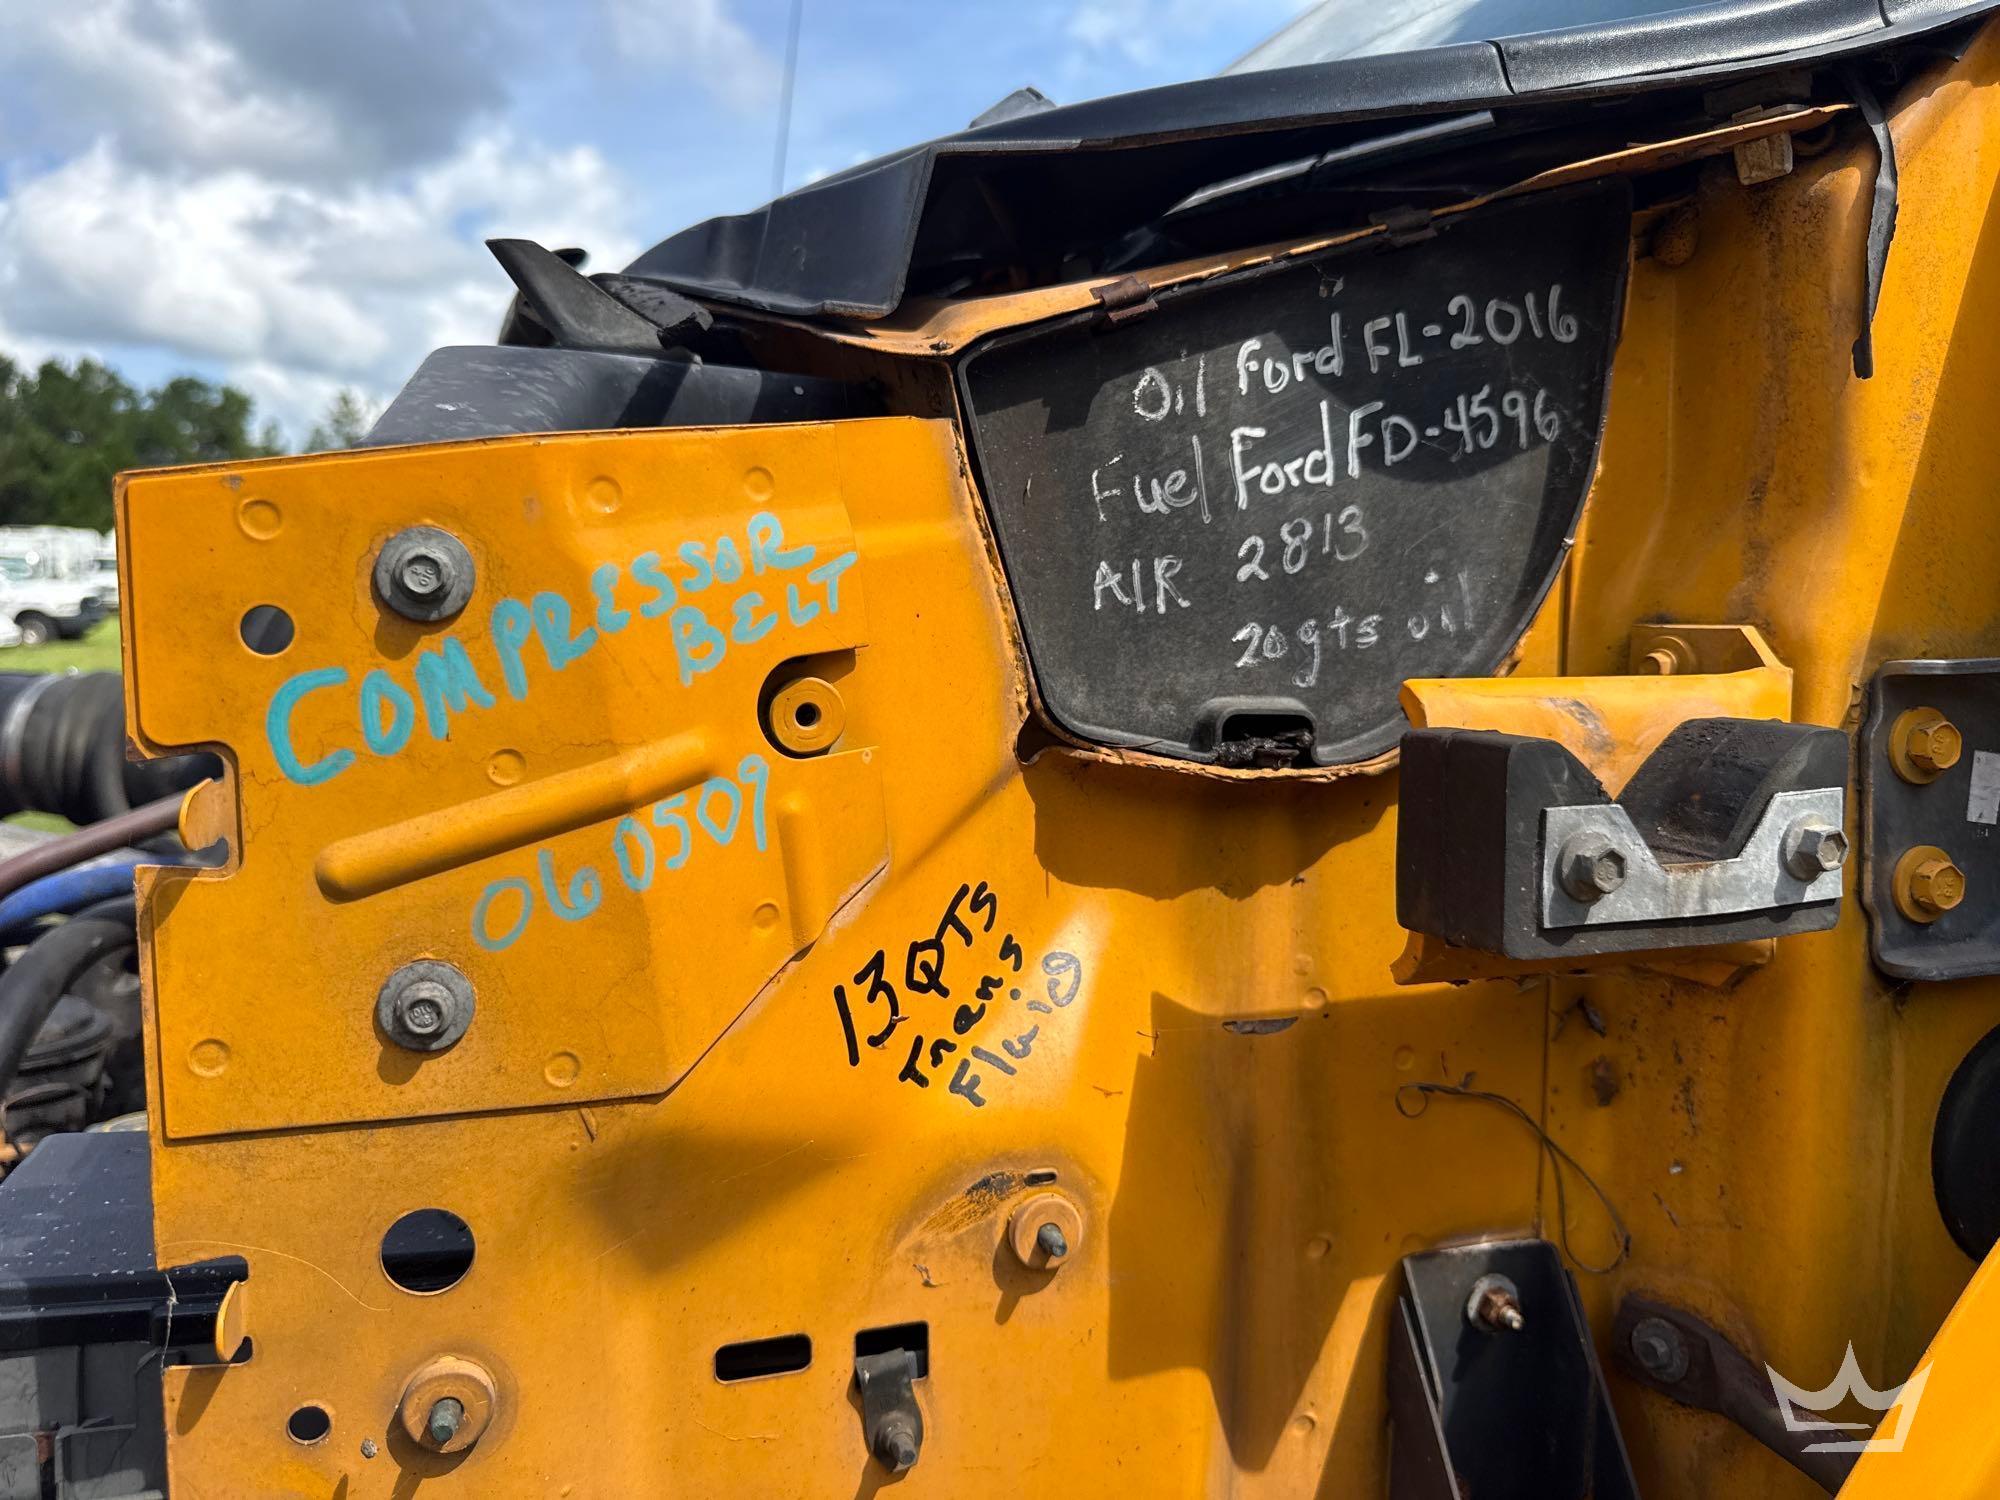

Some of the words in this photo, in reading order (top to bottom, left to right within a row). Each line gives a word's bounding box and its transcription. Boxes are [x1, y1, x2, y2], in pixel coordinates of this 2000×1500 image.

[1133, 353, 1207, 421] Oil
[1237, 311, 1343, 395] Ford
[1363, 284, 1579, 375] FL-2016
[1092, 435, 1213, 523] Fuel
[1229, 400, 1334, 510] Ford
[1347, 384, 1560, 480] FD-4596
[670, 551, 858, 686] BELT
[1093, 555, 1192, 615] AIR
[1236, 505, 1371, 583] 2813
[266, 511, 816, 786] COMPRESSOR
[898, 934, 1023, 1088] Trans
